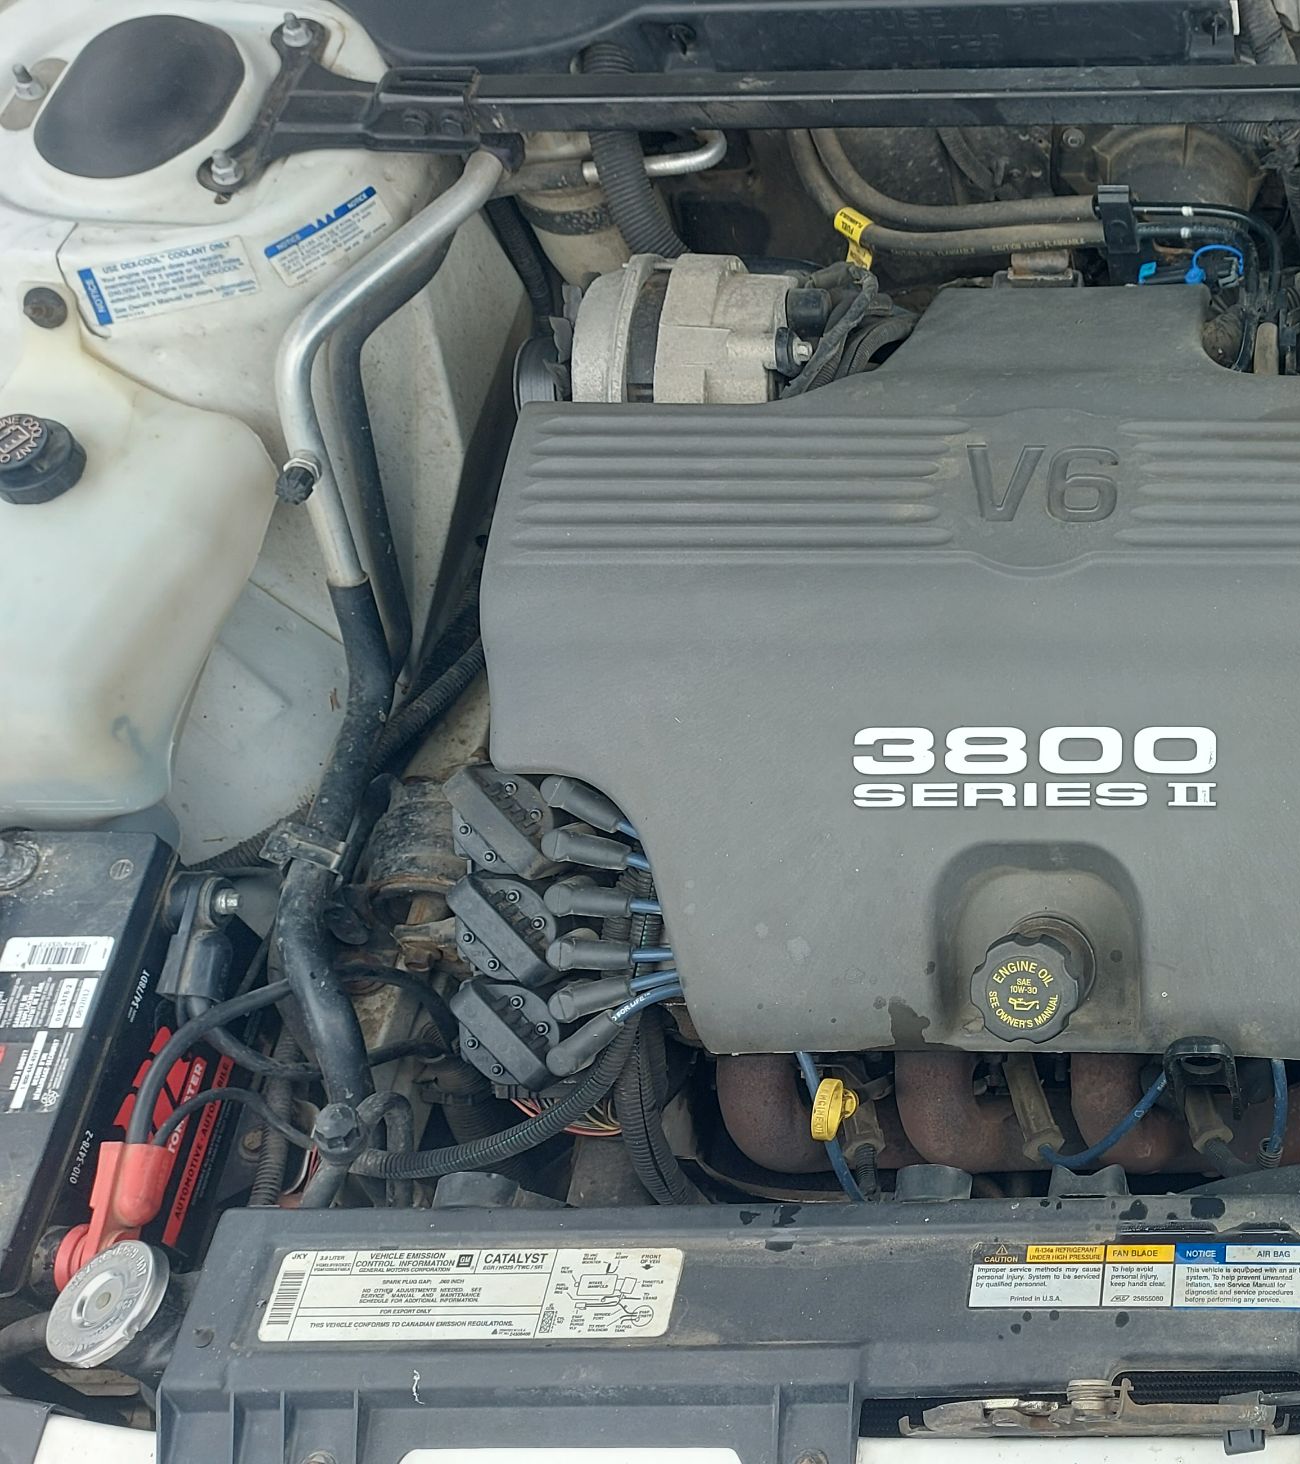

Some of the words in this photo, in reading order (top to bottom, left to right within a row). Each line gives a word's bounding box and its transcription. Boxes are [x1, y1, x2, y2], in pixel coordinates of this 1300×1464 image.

[966, 444, 1120, 523] V6
[853, 726, 1217, 775] 3800
[853, 782, 1148, 807] SERIES
[1167, 782, 1217, 807] II
[992, 960, 1038, 984] ENGINE
[1037, 968, 1054, 987] OIL
[1016, 978, 1032, 986] SAE
[131, 969, 151, 1009] 34/78DT
[1010, 986, 1038, 995] 10W-30
[988, 991, 1000, 1009] SEE
[995, 1008, 1034, 1028] OWNER'S
[1035, 994, 1059, 1025] MANUAL
[69, 1130, 94, 1185] 010-3478-2
[174, 1149, 203, 1219] AUTOMOTIVE
[355, 1260, 395, 1268] CONTROL
[370, 1252, 405, 1260] VEHICLE
[406, 1252, 446, 1260] EMISSION
[484, 1253, 549, 1264] CATALYST
[1185, 1250, 1217, 1258] NOTICE
[1207, 1296, 1242, 1304] performing
